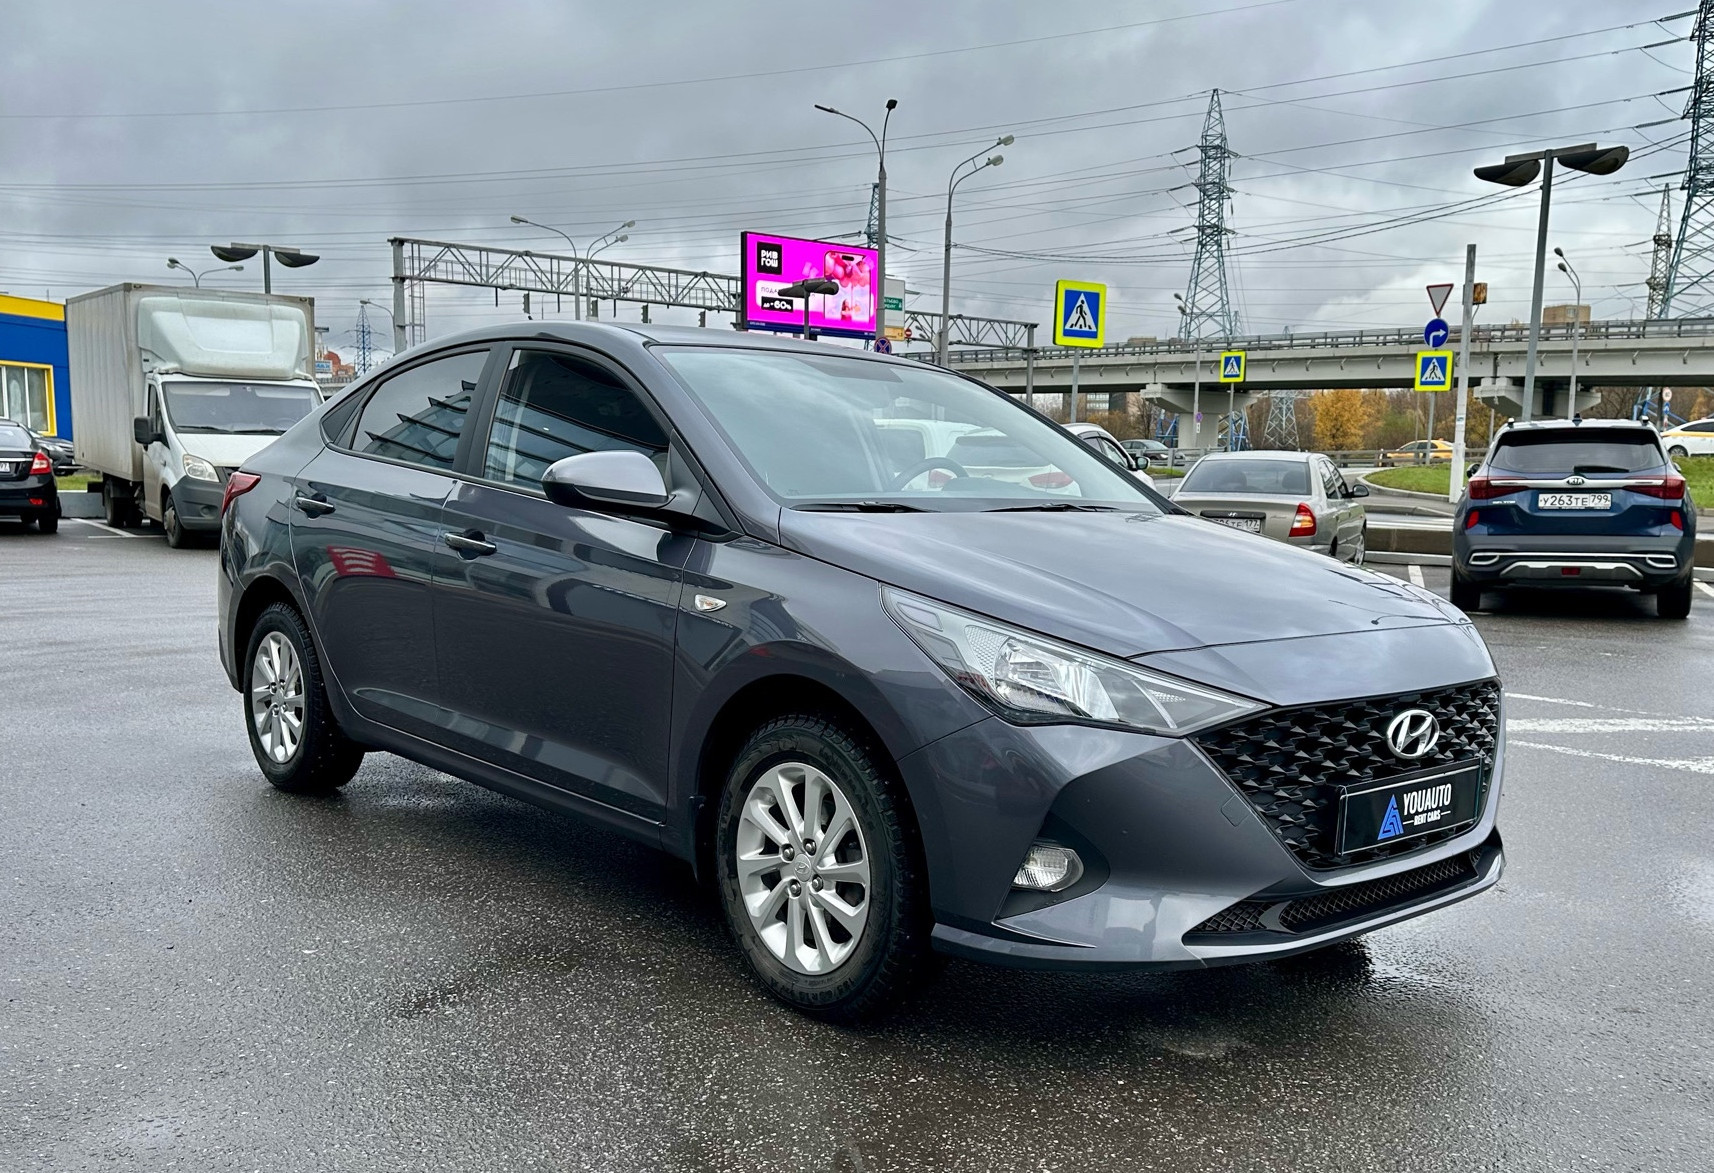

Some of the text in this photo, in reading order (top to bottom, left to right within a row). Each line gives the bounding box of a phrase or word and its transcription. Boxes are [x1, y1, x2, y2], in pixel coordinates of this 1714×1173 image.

[761, 250, 778, 259] РИВ
[761, 258, 778, 267] ГОШ
[1591, 494, 1609, 503] 799
[1403, 783, 1452, 816] YOUAUTO
[1413, 809, 1441, 826] RENT CARS
